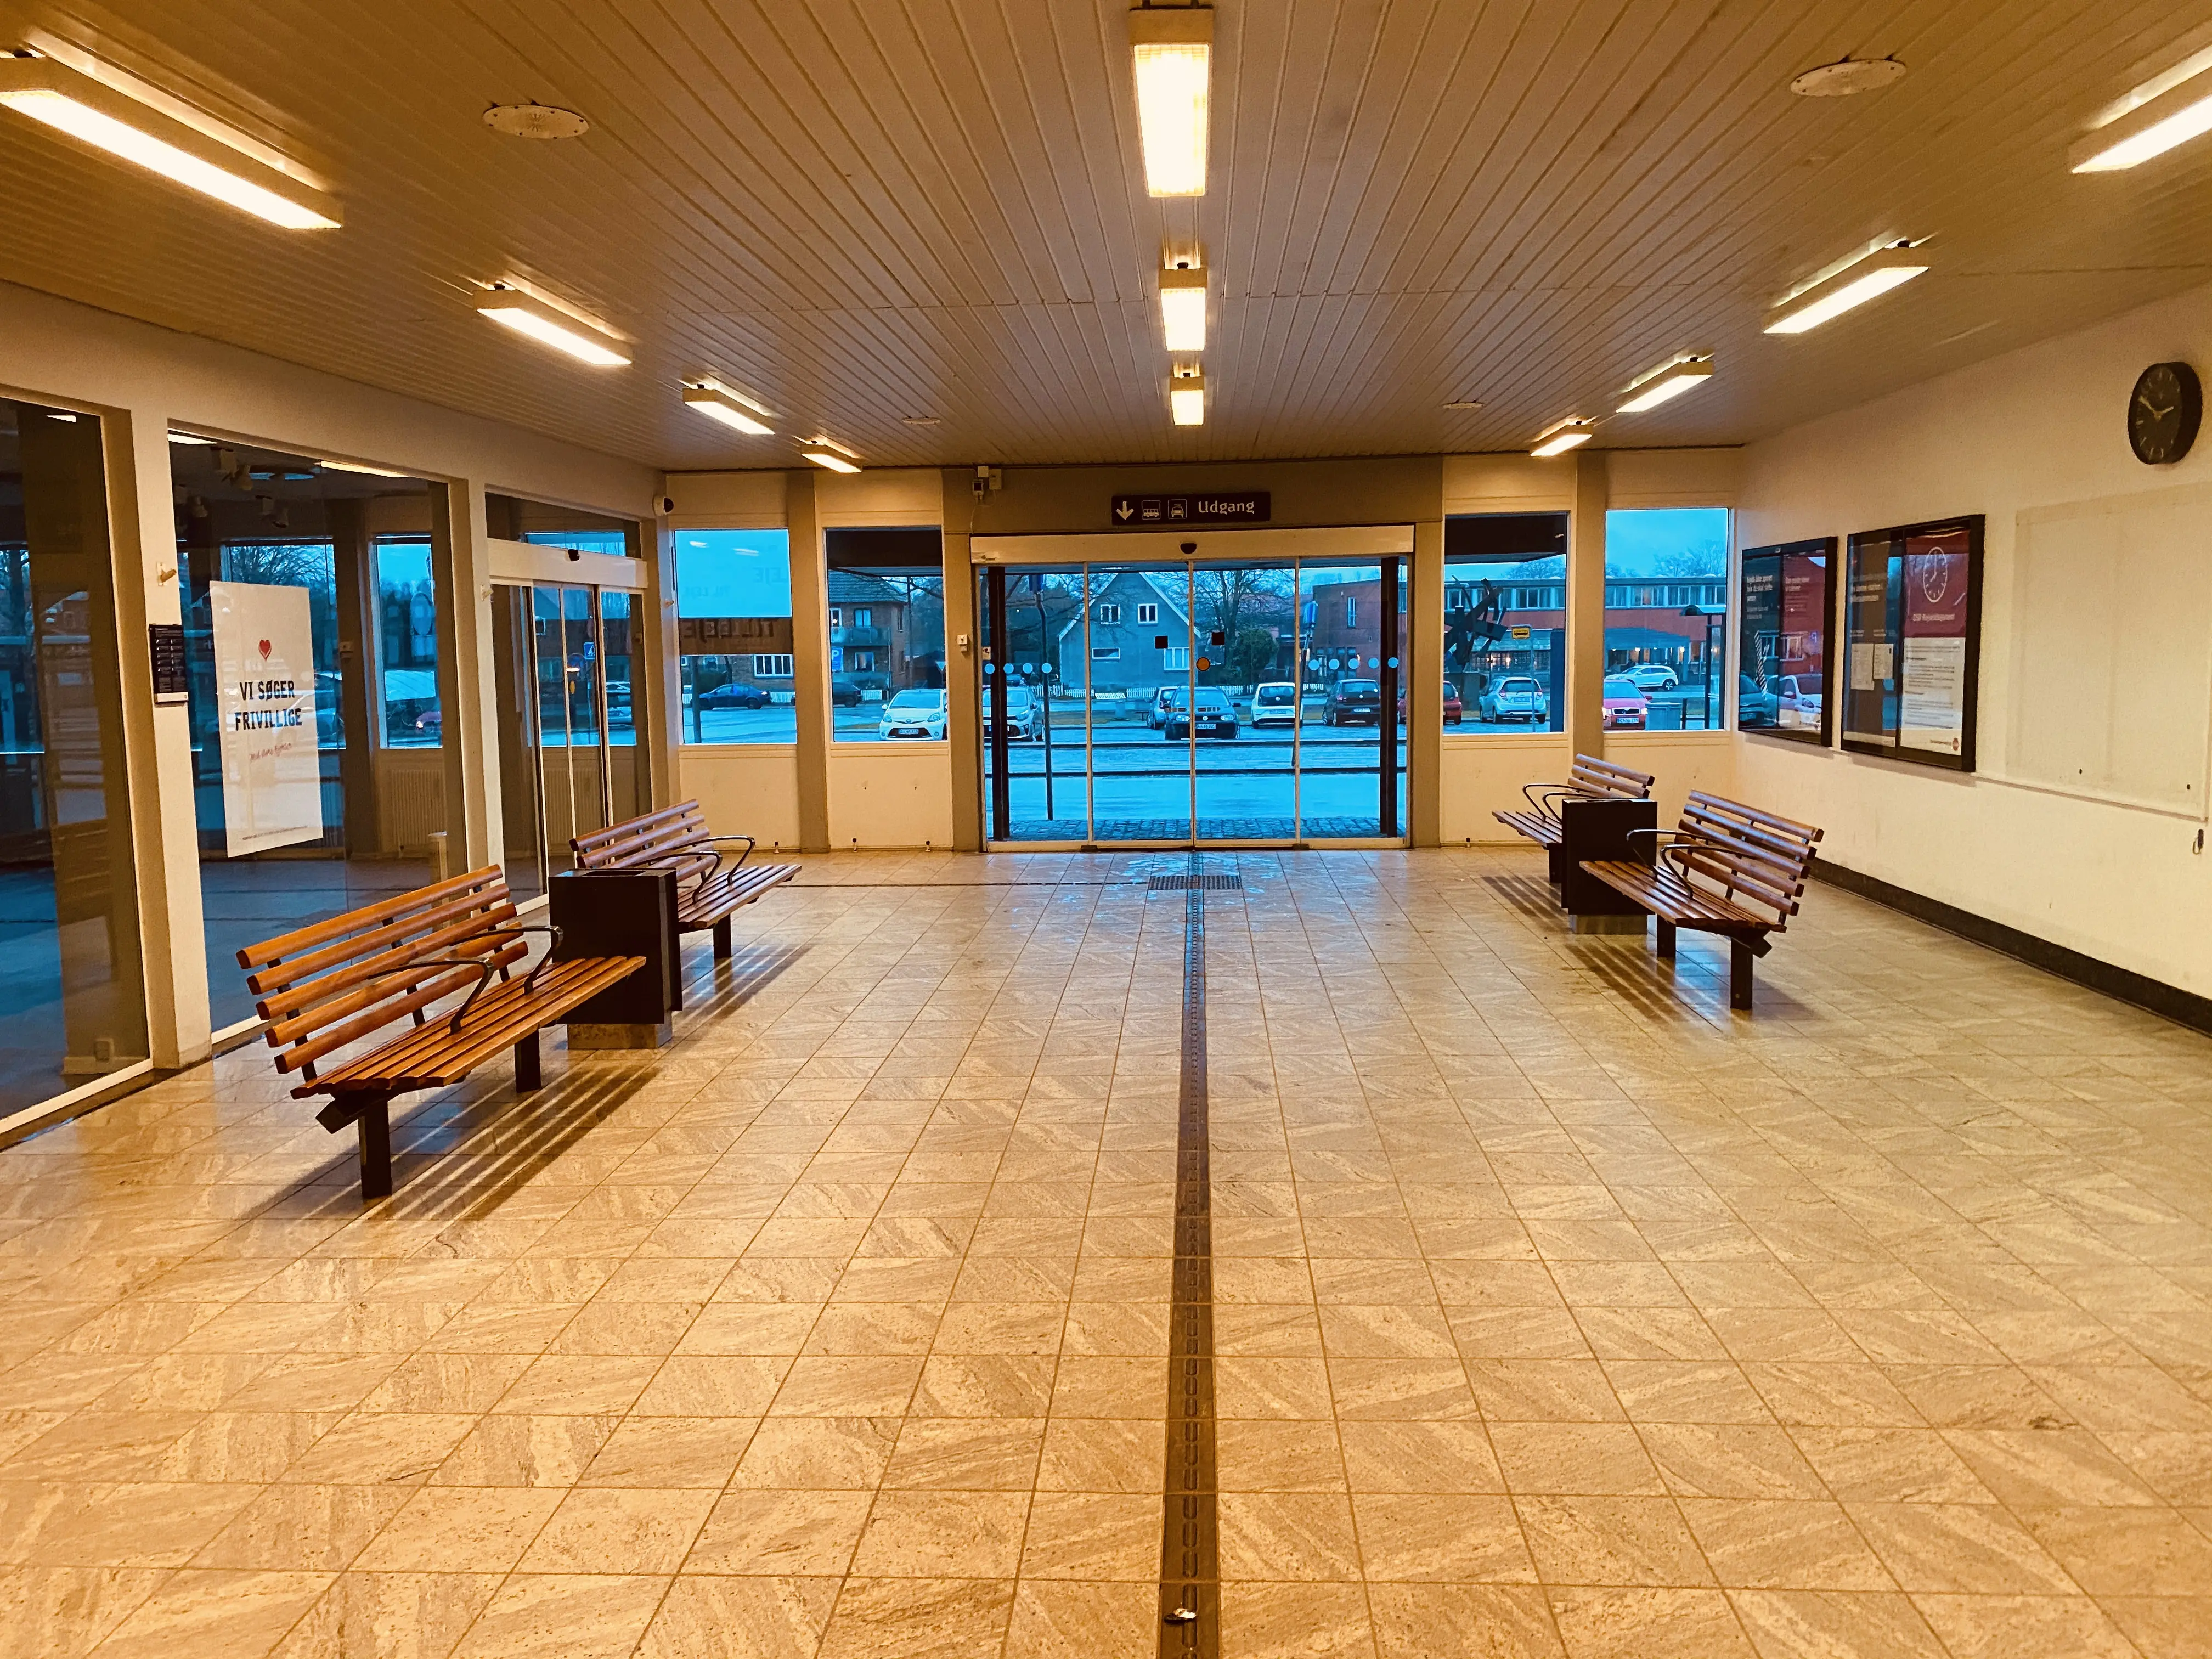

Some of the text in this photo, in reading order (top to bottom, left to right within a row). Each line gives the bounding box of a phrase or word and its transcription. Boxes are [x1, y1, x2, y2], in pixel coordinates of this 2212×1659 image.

[1198, 500, 1255, 515] Udgang
[831, 650, 839, 661] P
[240, 680, 295, 701] VI SØGER
[235, 708, 302, 731] FRIVILLIGE
